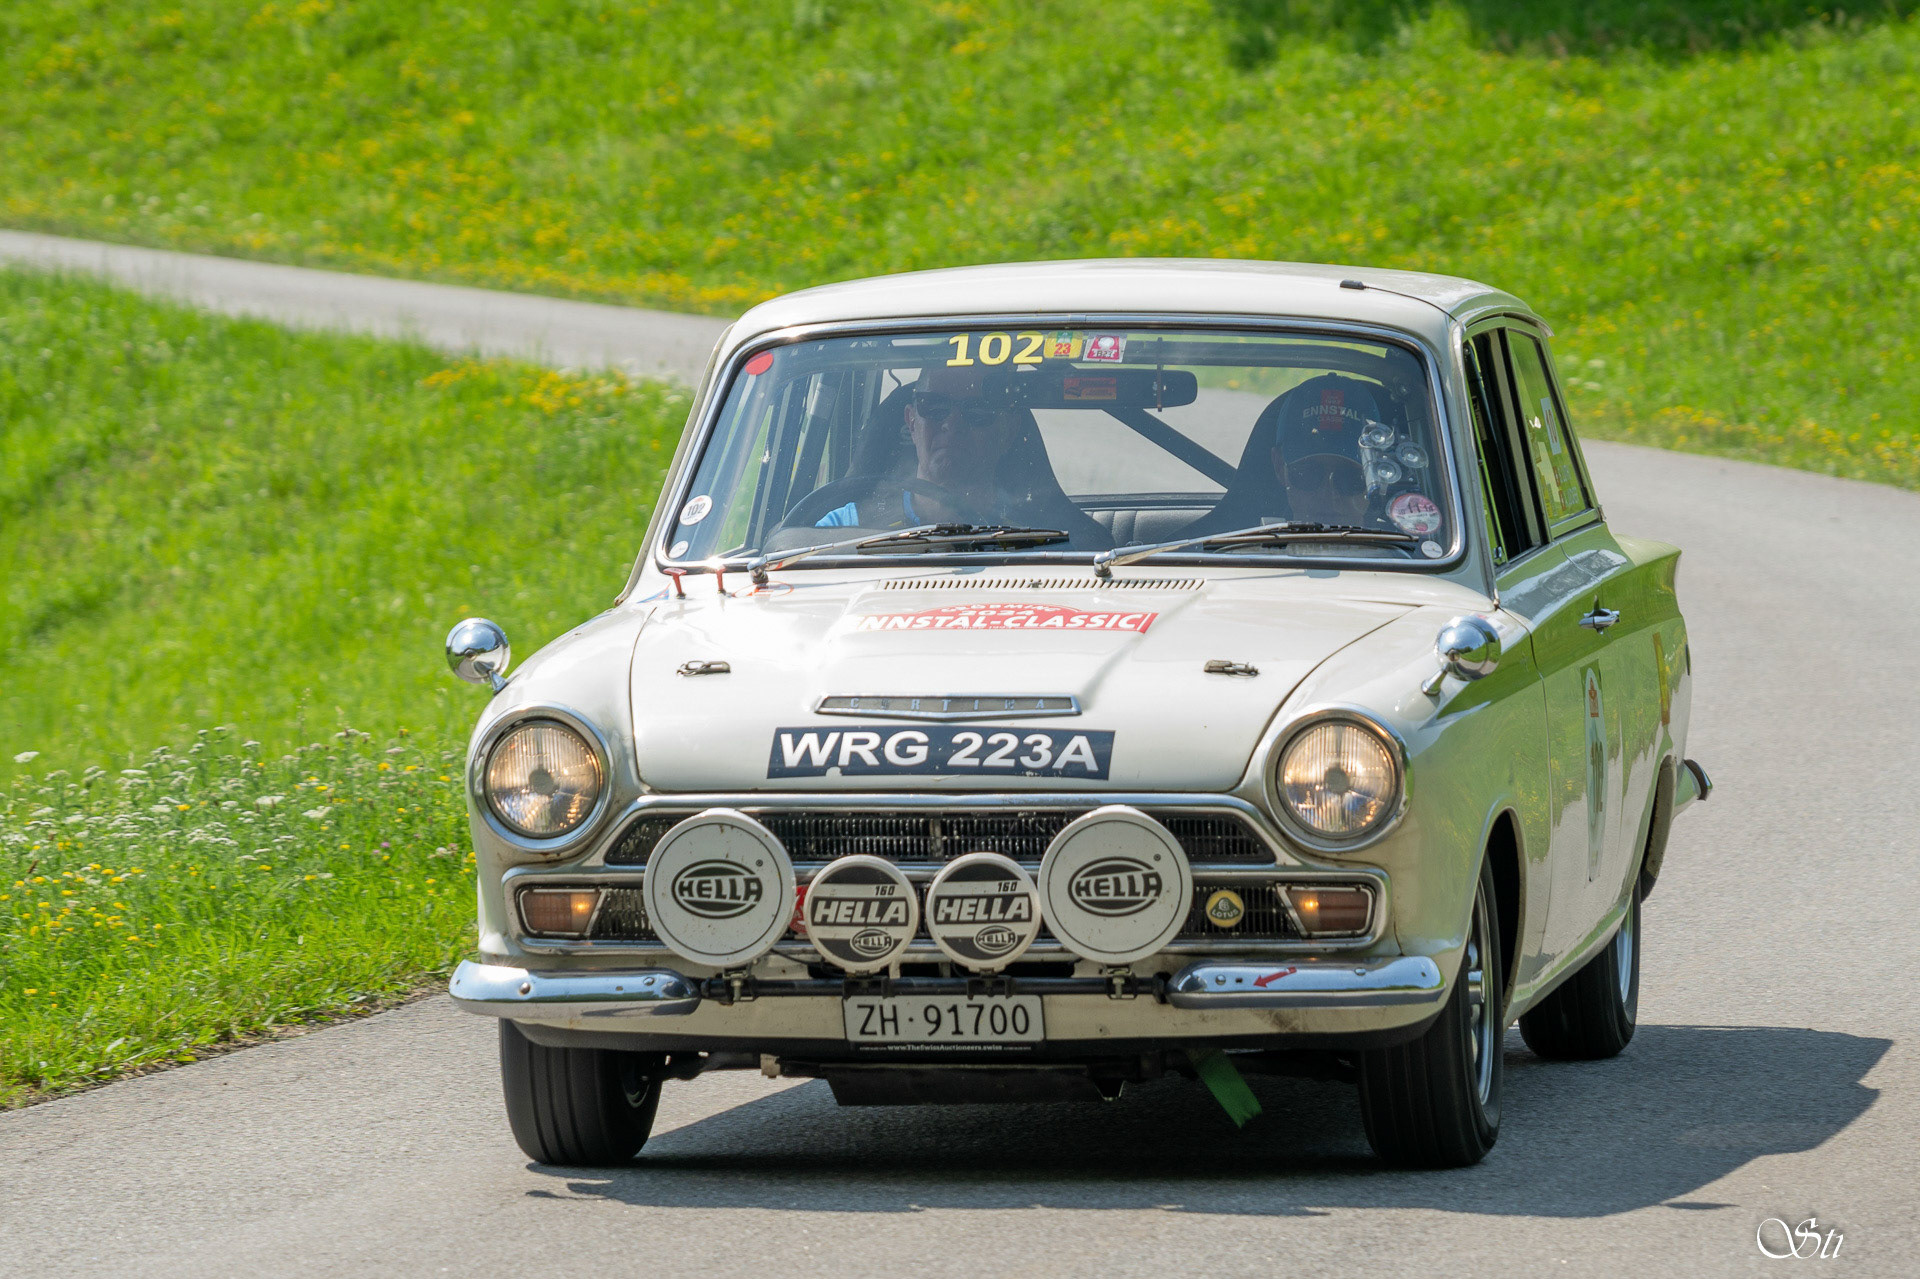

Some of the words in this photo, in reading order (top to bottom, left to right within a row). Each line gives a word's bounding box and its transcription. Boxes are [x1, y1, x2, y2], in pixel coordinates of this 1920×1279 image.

[946, 331, 1044, 367] 102
[1053, 342, 1072, 356] 23
[1302, 404, 1361, 421] ENNSTAL
[687, 503, 706, 517] 102
[780, 731, 930, 768] WRG
[947, 731, 1099, 772] 223A
[678, 876, 763, 902] HELLA
[874, 885, 896, 896] 160
[997, 881, 1018, 893] 160
[1075, 871, 1162, 899] HELLA
[813, 900, 907, 924] HELLA
[937, 896, 1032, 922] HELLA
[1211, 908, 1239, 919] LOTUS
[853, 932, 892, 948] HELLA
[976, 928, 1016, 944] HELLA
[857, 1004, 900, 1036] ZH
[923, 1003, 1030, 1037] 91700
